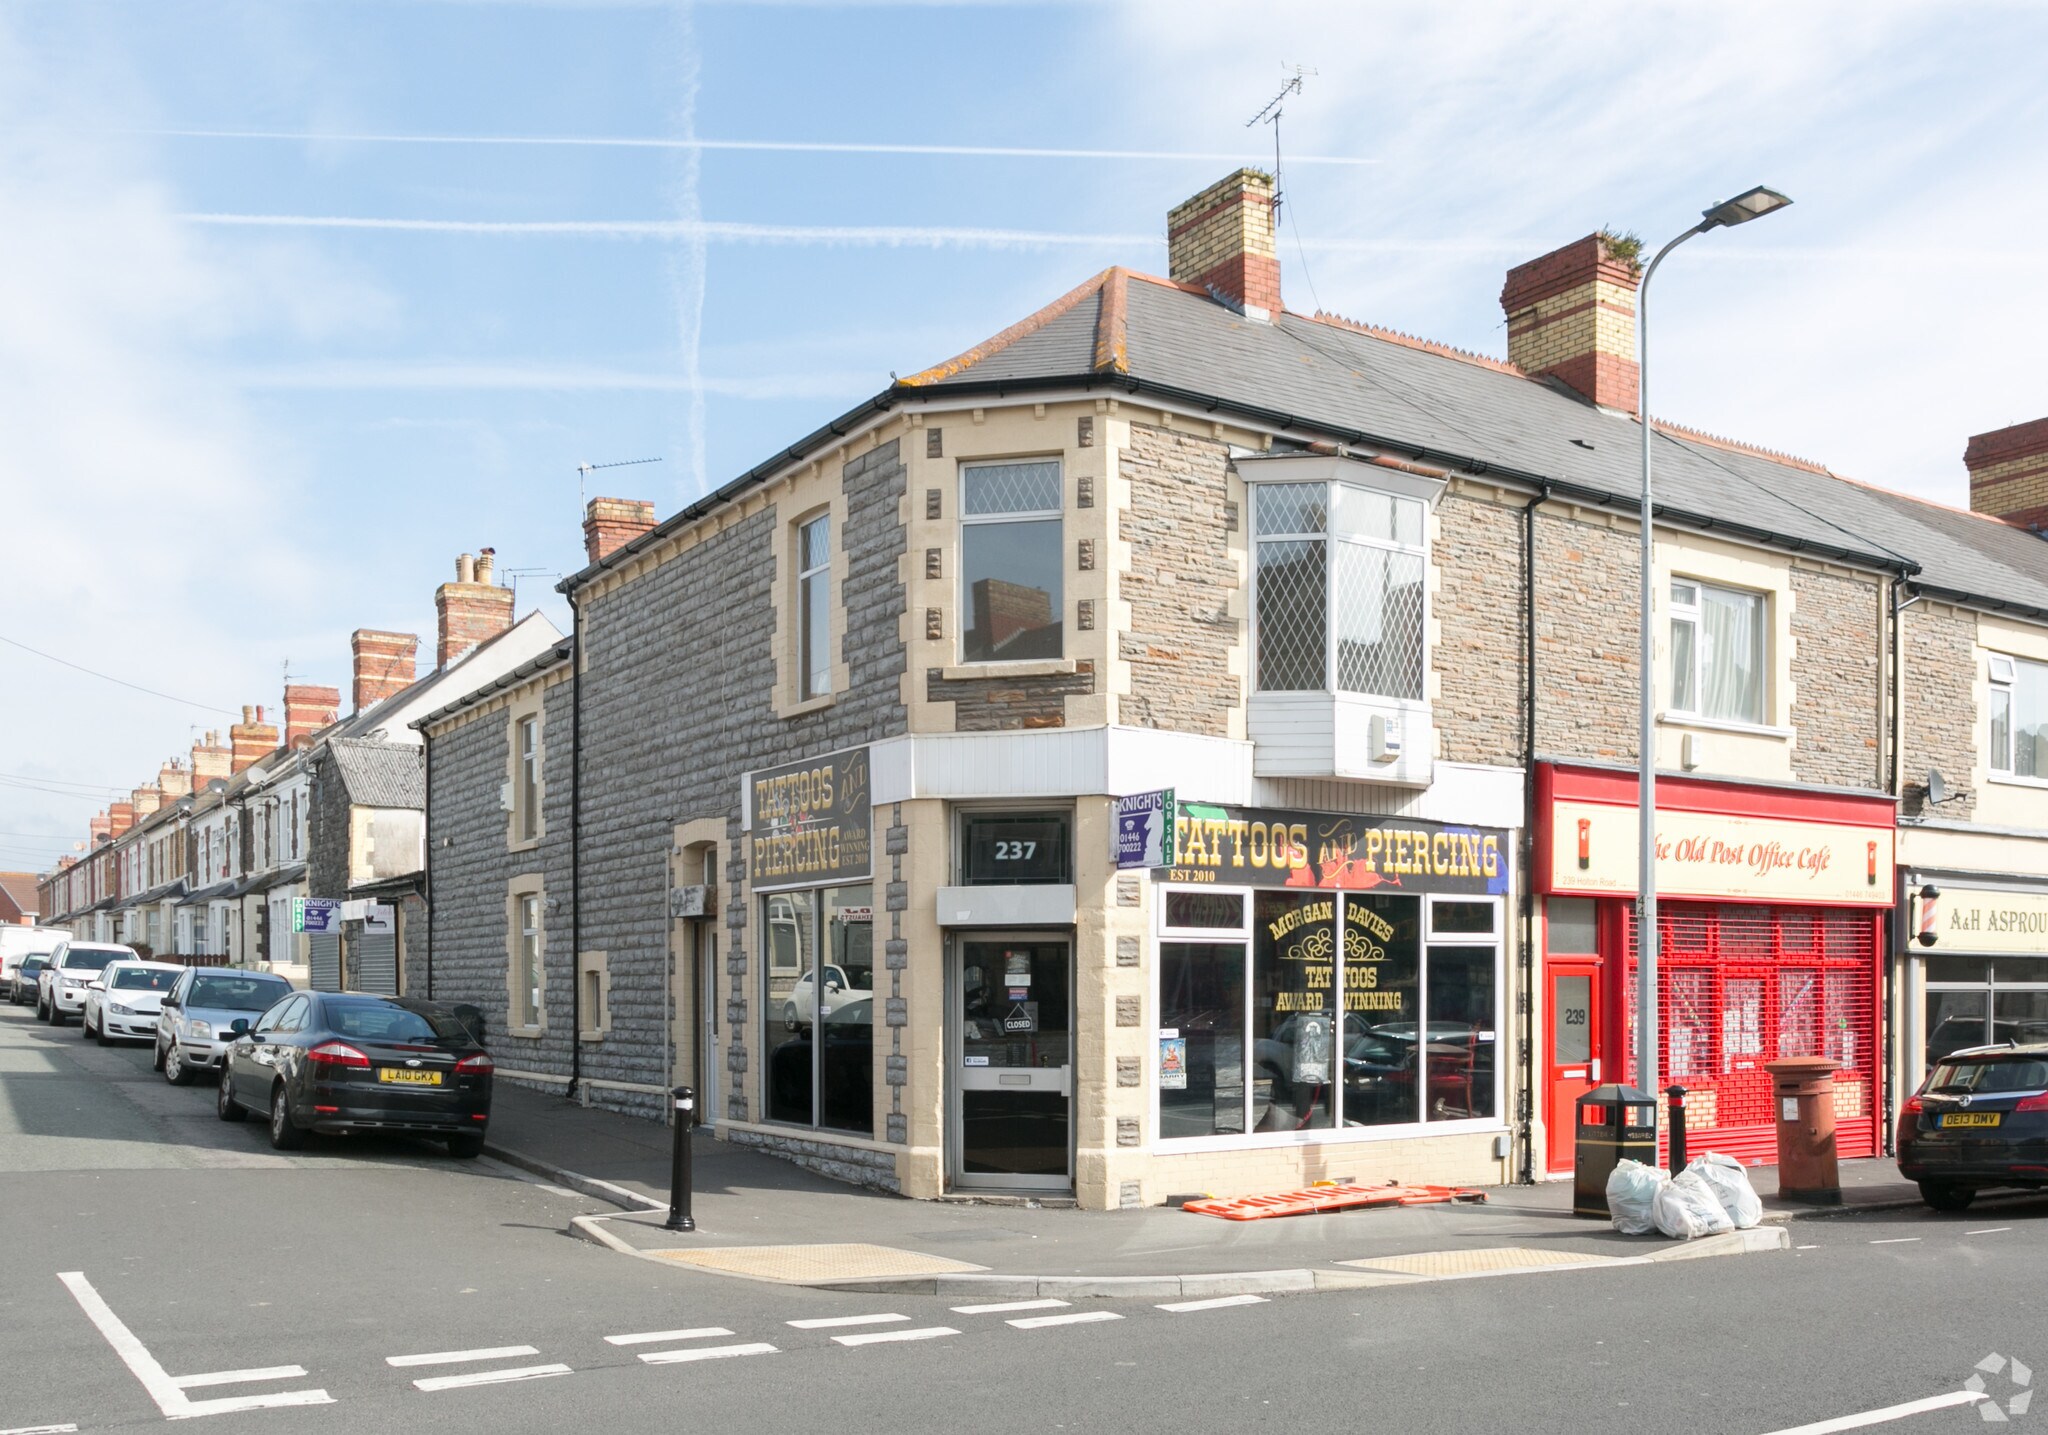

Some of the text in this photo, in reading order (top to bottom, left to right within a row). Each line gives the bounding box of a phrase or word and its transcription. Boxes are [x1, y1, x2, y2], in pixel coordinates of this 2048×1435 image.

[755, 763, 867, 820] TATTOOS AND
[1119, 792, 1162, 812] KNIGHTS
[1165, 790, 1173, 820] FOR
[843, 828, 866, 841] AWARD
[1119, 832, 1140, 843] 01446
[754, 826, 840, 877] PIERCING
[840, 840, 870, 853] WINNING
[995, 841, 1037, 860] 237
[1118, 842, 1142, 853] 700222
[1165, 824, 1173, 864] SALE
[1316, 832, 1358, 865] AND
[1364, 828, 1498, 877] PIERCING
[842, 854, 854, 866] EST
[1654, 833, 1671, 861] he
[1675, 834, 1711, 863] Old
[1709, 839, 1744, 865] Post
[1747, 840, 1794, 877] Office
[1170, 868, 1216, 882] EST 2010
[305, 899, 341, 908] KNIGHTS
[1268, 901, 1395, 943] MORGAN DAVIES
[1987, 910, 2047, 934] ASPROU
[1276, 992, 1324, 1011] AWARD
[1006, 1020, 1031, 1029] CLOSED
[1565, 1008, 1585, 1025] 239
[414, 1071, 435, 1082] GKX
[1973, 1114, 1996, 1125] DMV
